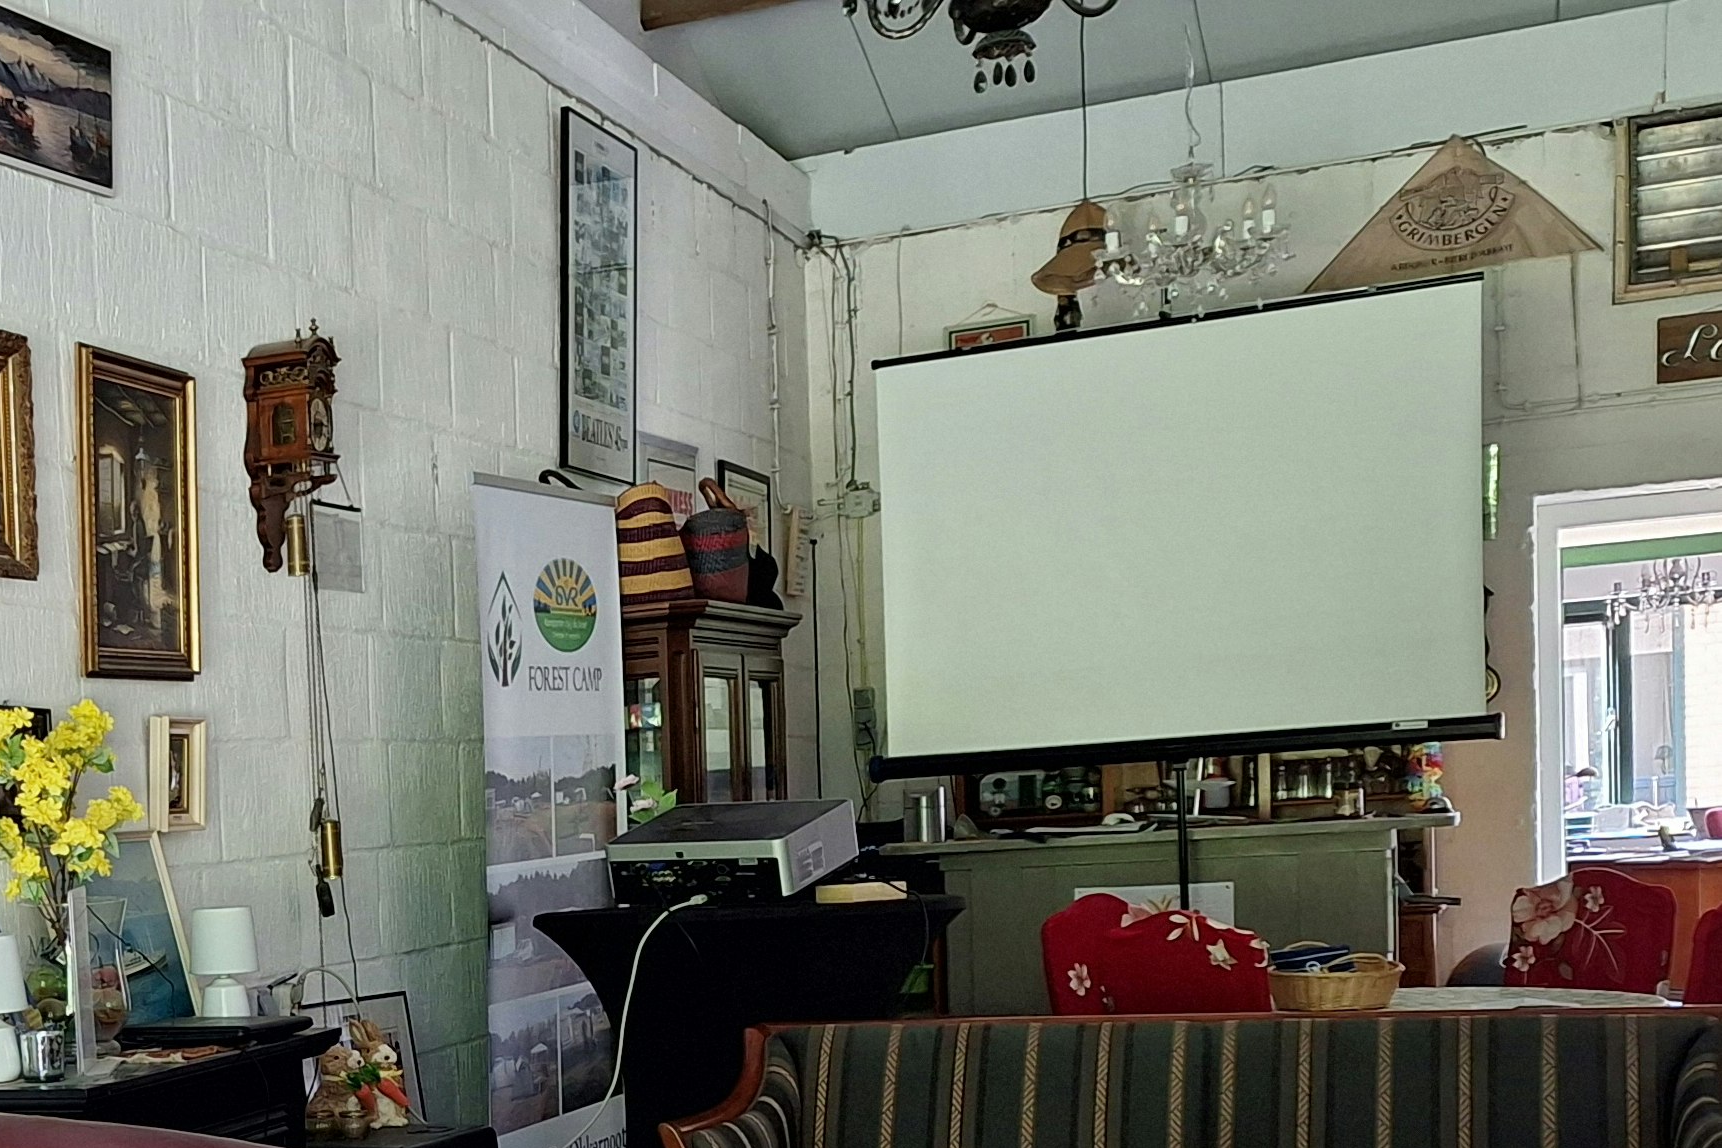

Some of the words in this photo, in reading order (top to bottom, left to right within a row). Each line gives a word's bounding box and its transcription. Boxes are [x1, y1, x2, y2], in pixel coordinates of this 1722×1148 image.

[1397, 203, 1509, 248] GRIMBERGEN
[528, 664, 570, 692] FOREST
[572, 665, 603, 692] CAMP
